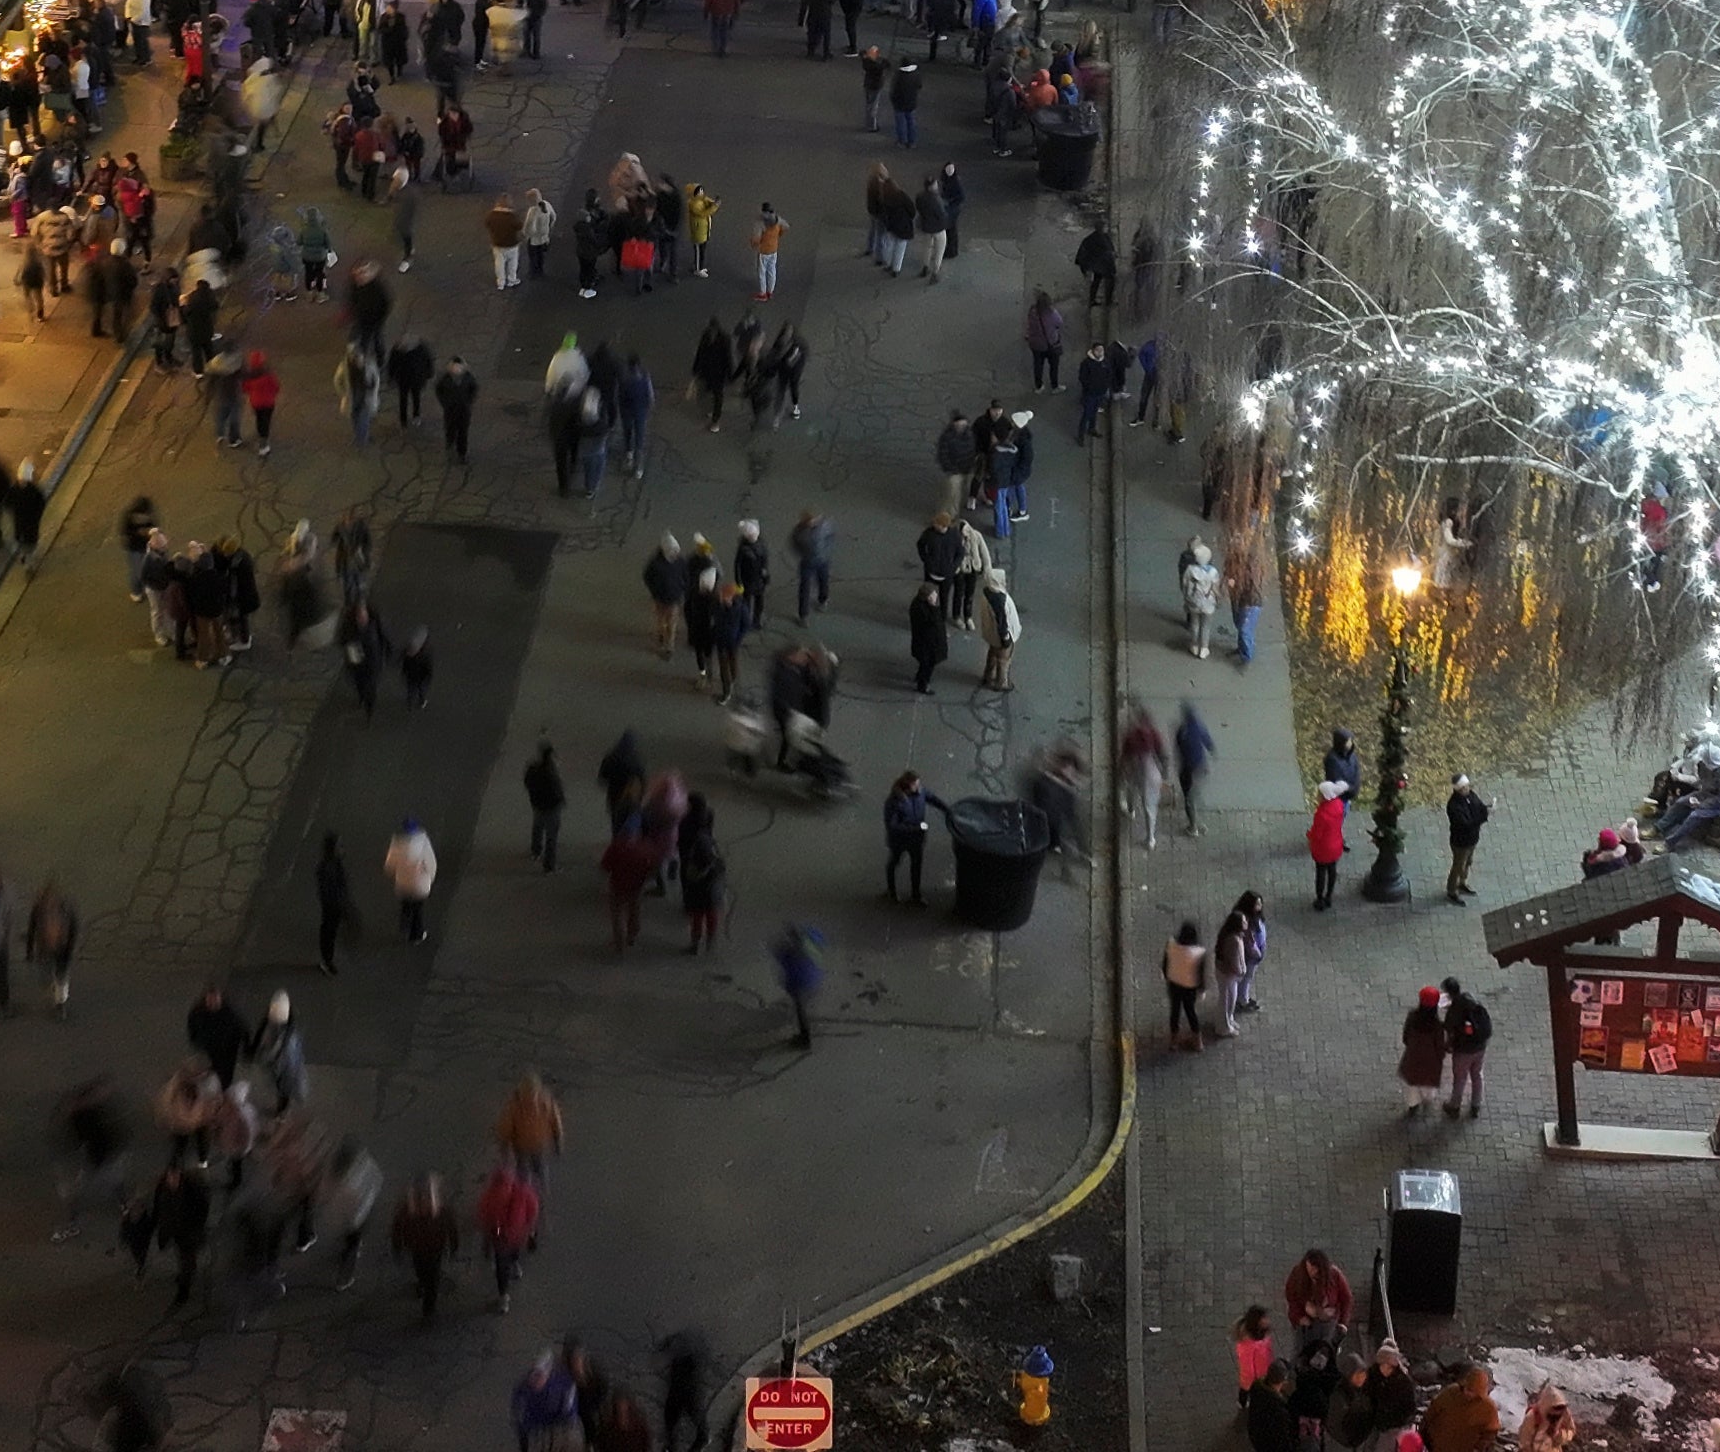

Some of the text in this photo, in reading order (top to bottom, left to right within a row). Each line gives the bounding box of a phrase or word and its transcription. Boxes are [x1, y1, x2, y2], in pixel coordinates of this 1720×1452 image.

[760, 1391, 818, 1403] DO NOT
[767, 1423, 812, 1434] ENTER
